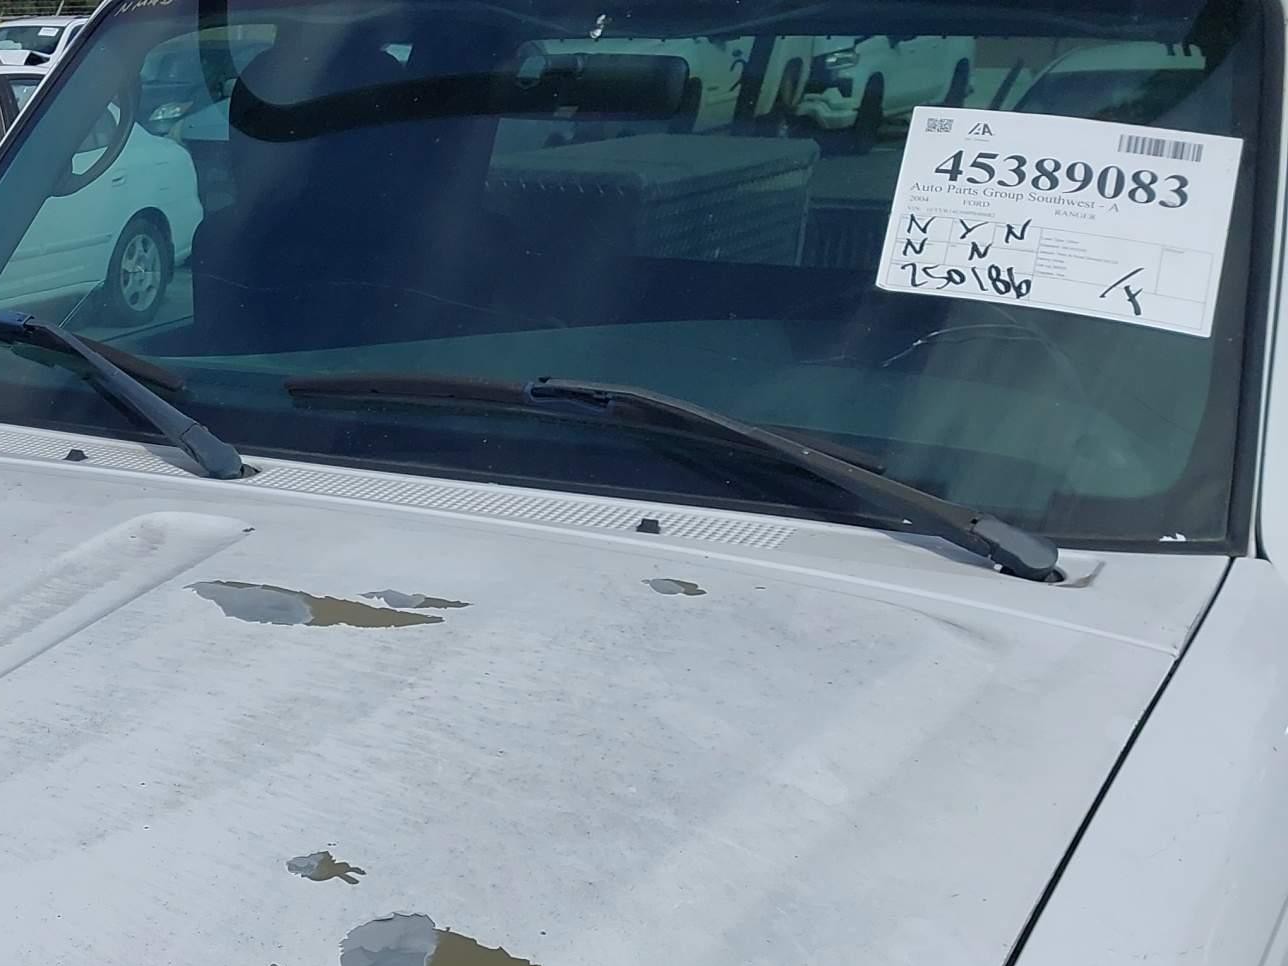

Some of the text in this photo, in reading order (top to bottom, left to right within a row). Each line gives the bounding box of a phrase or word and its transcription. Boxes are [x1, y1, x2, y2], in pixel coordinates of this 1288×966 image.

[935, 150, 1190, 209] 45389083
[910, 182, 943, 193] Auto
[946, 185, 979, 197] Parts
[983, 187, 1024, 202] Group
[1028, 192, 1096, 209] Southwest
[1108, 203, 1120, 213] A
[963, 199, 990, 208] FORD
[907, 213, 936, 234] N
[1005, 219, 1032, 243] N
[902, 237, 993, 260] N N
